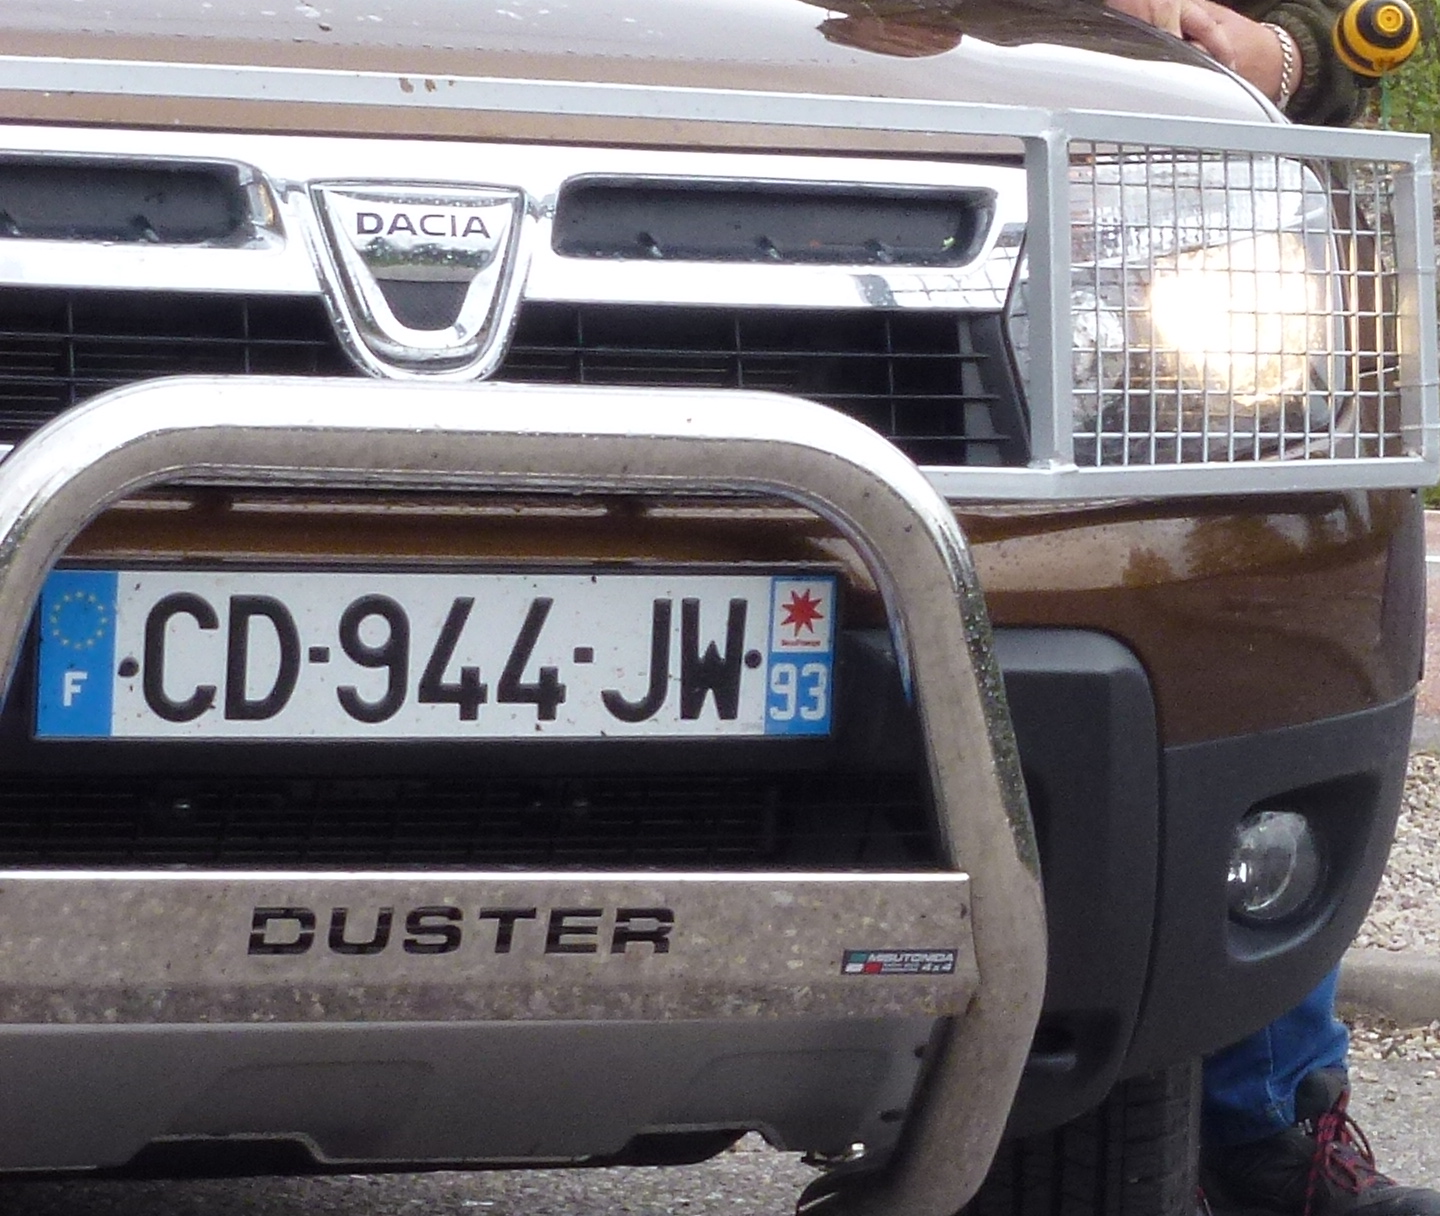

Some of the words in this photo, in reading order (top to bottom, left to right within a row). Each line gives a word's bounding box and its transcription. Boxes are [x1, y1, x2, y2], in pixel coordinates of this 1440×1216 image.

[356, 211, 491, 240] DACIA
[142, 592, 749, 725] CD-944-JW
[62, 671, 88, 708] F
[770, 662, 827, 721] 93
[246, 906, 676, 956] DUSTER
